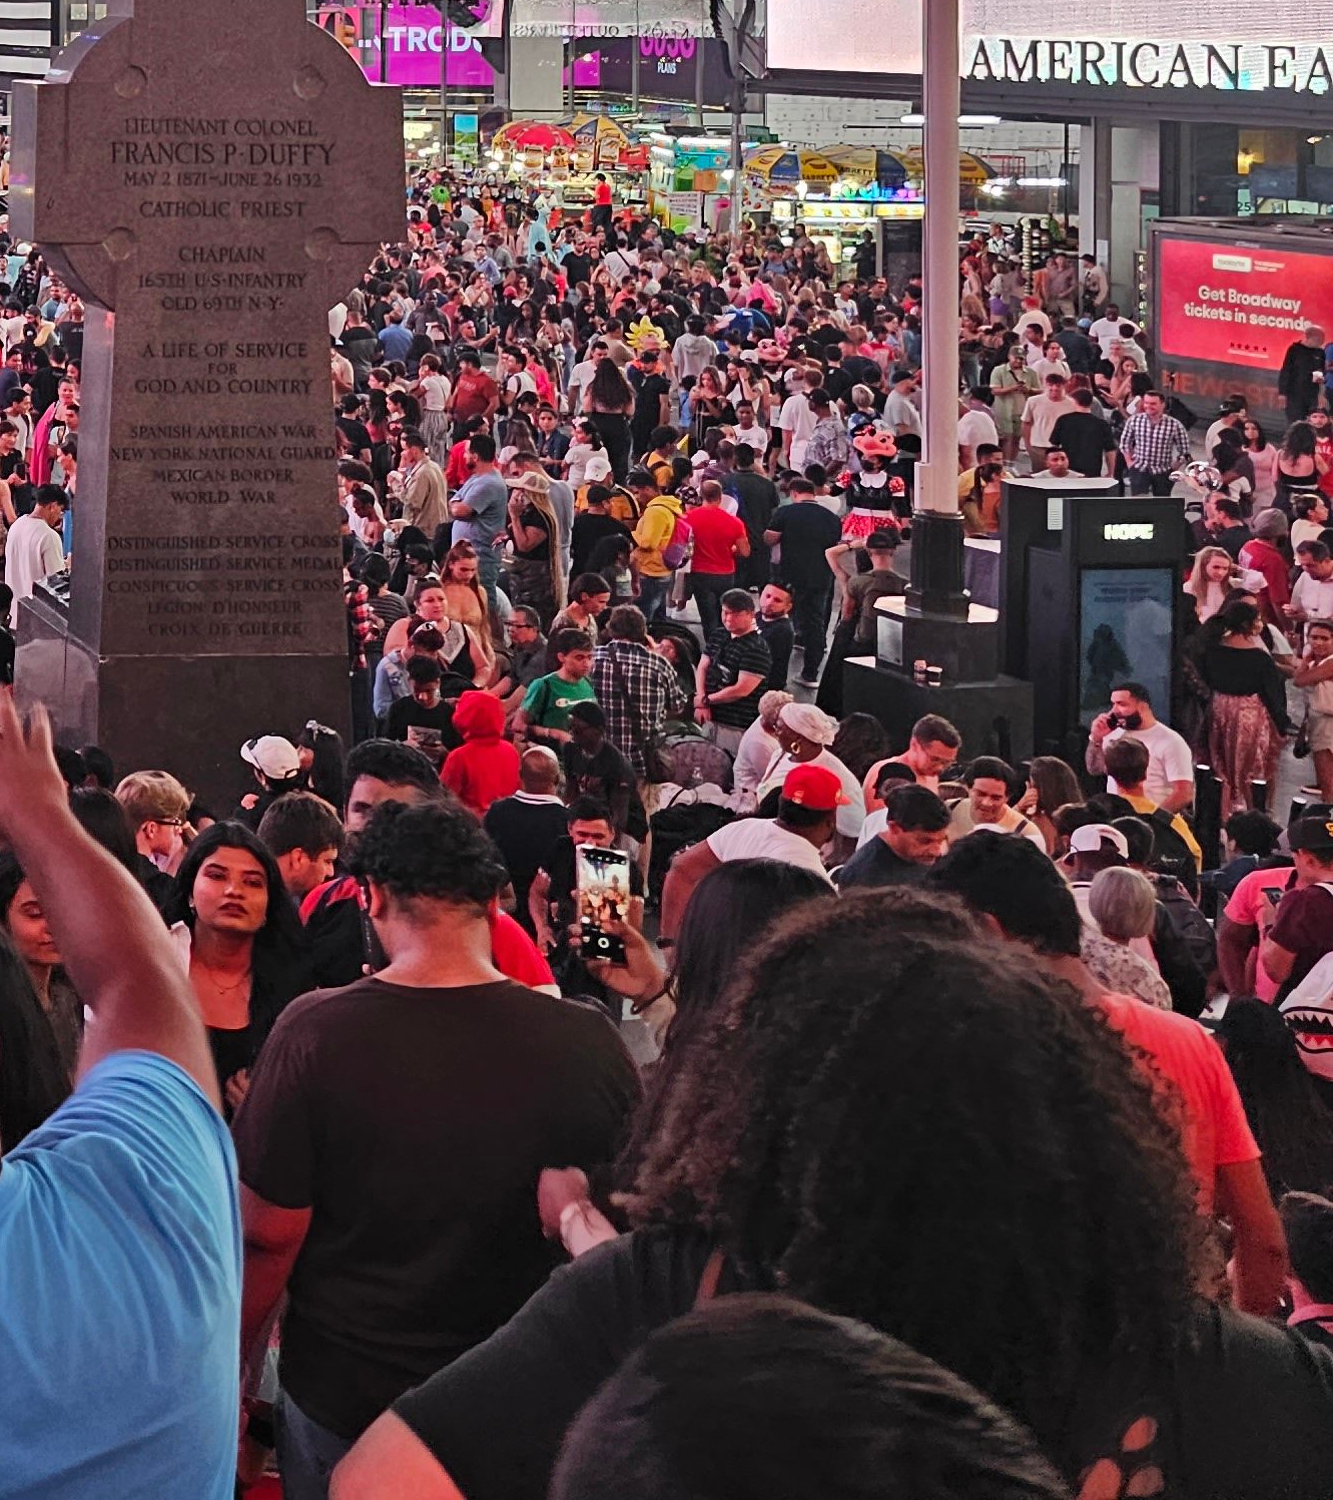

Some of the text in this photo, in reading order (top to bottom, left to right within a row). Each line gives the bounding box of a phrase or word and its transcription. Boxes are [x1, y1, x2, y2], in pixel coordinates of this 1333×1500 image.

[656, 61, 677, 74] PLANS
[968, 37, 1242, 87] AMERICAN
[124, 118, 318, 137] LIEUTENANT COLONEL
[110, 141, 336, 167] FRANCIS DUFFY
[123, 171, 323, 188] MAY 2 26 1932
[139, 201, 306, 218] CATHOLIC PRIEST
[178, 247, 266, 263] CHAPLAIN
[138, 273, 186, 288] 165TH
[161, 296, 243, 311] OLD 69TH
[1198, 285, 1302, 314] Get Broadway
[1183, 303, 1247, 324] tickets in
[141, 342, 309, 358] A LIFE OF SERVICE
[208, 362, 238, 375] FOR
[134, 378, 314, 395] GOD AND COUNTRY
[130, 425, 317, 440] SPANISH AMERICAN WAR
[111, 447, 335, 461] NEW YORK NATIONAL GUARD
[152, 469, 295, 483] MEXICAN BORDER
[171, 490, 276, 504] WORLD WAR
[1102, 523, 1155, 541] HOPE
[107, 535, 340, 550] DISTINGUISHED SERVICE CROSS
[107, 557, 342, 572] DISTINGUISHED SERVICE MEDAL
[226, 578, 341, 592] SERVICE CROSS
[148, 601, 206, 614] LEGION
[148, 621, 302, 637] CROIX DE GUERRE
